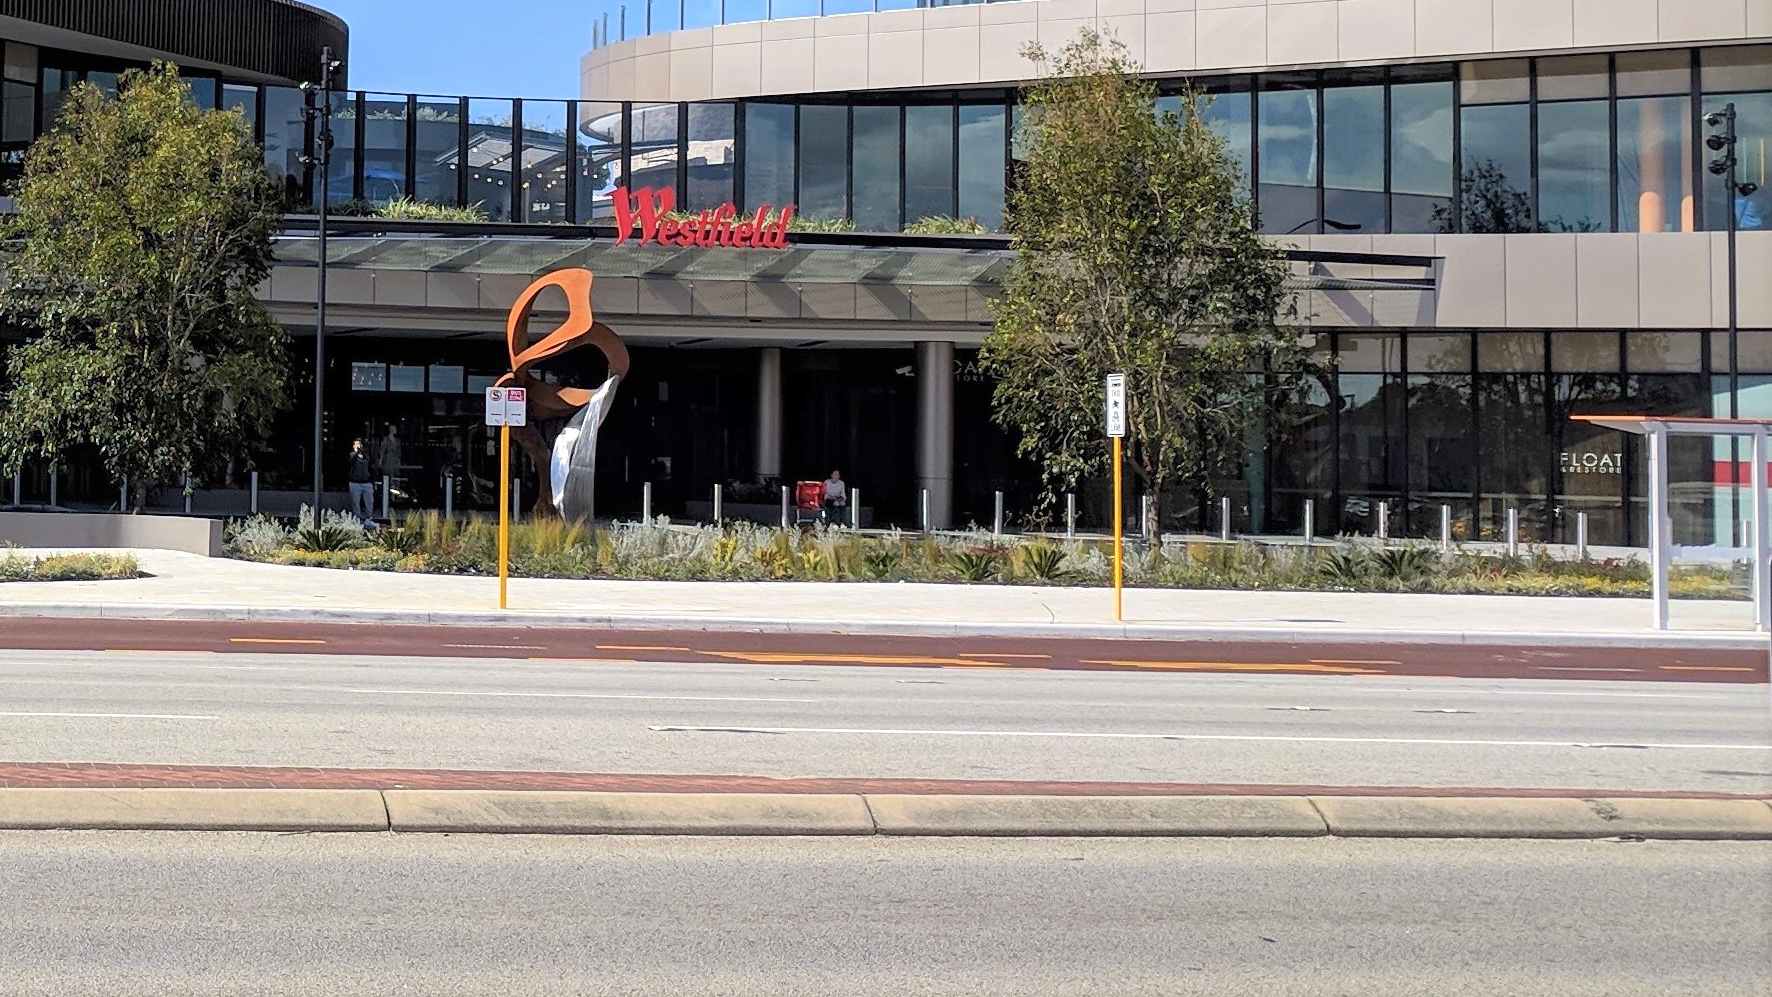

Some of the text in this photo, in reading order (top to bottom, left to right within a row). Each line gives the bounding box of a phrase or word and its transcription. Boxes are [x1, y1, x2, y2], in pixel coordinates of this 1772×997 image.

[605, 185, 797, 249] Westfield
[1560, 452, 1622, 467] FLOAT
[1569, 466, 1622, 474] RESTORE
